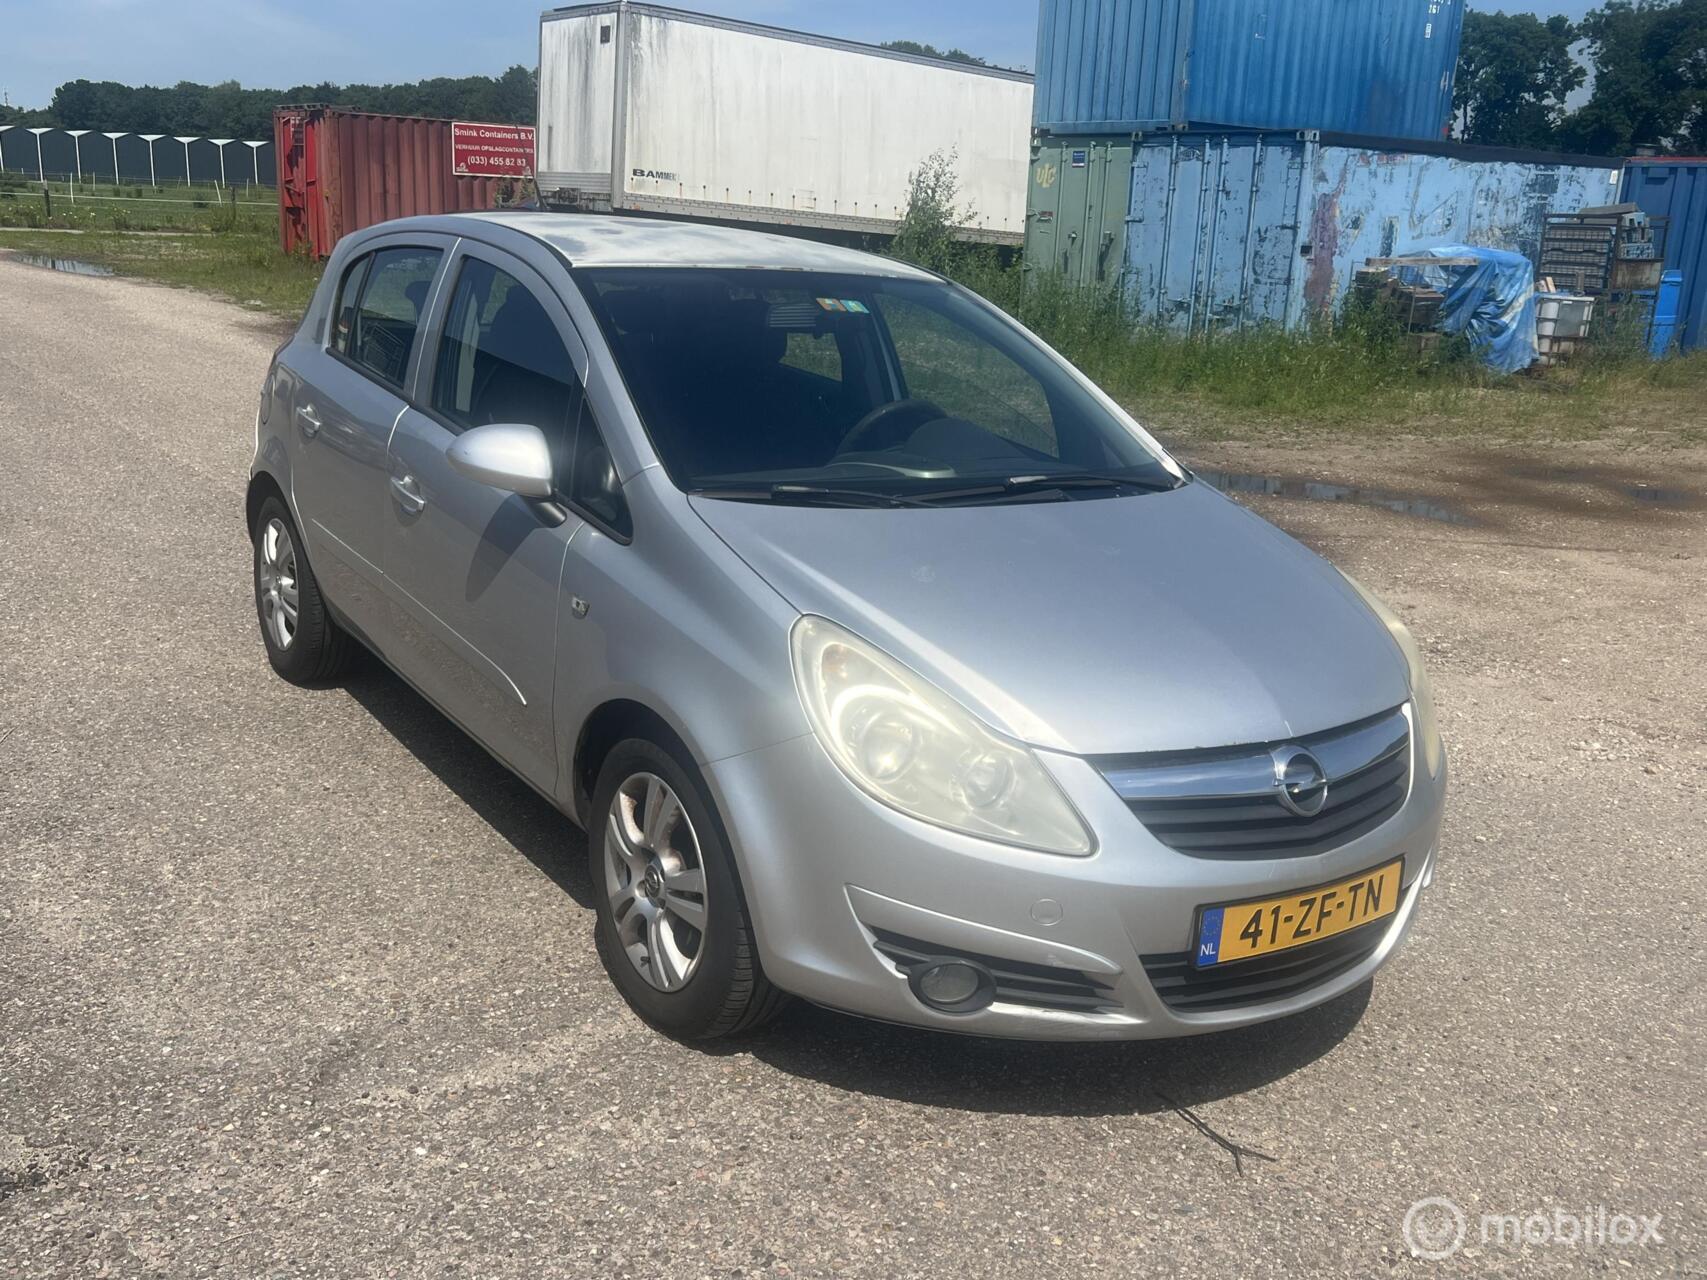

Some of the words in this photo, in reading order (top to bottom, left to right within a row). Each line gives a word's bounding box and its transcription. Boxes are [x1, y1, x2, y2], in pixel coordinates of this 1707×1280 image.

[455, 128, 478, 136] Smink
[479, 129, 519, 139] Containers
[520, 132, 534, 140] B.V.
[467, 156, 488, 166] (033)
[489, 156, 504, 166] 455
[505, 158, 516, 166] 82
[1239, 874, 1385, 949] 41-ZF-TN
[1200, 943, 1216, 957] NL
